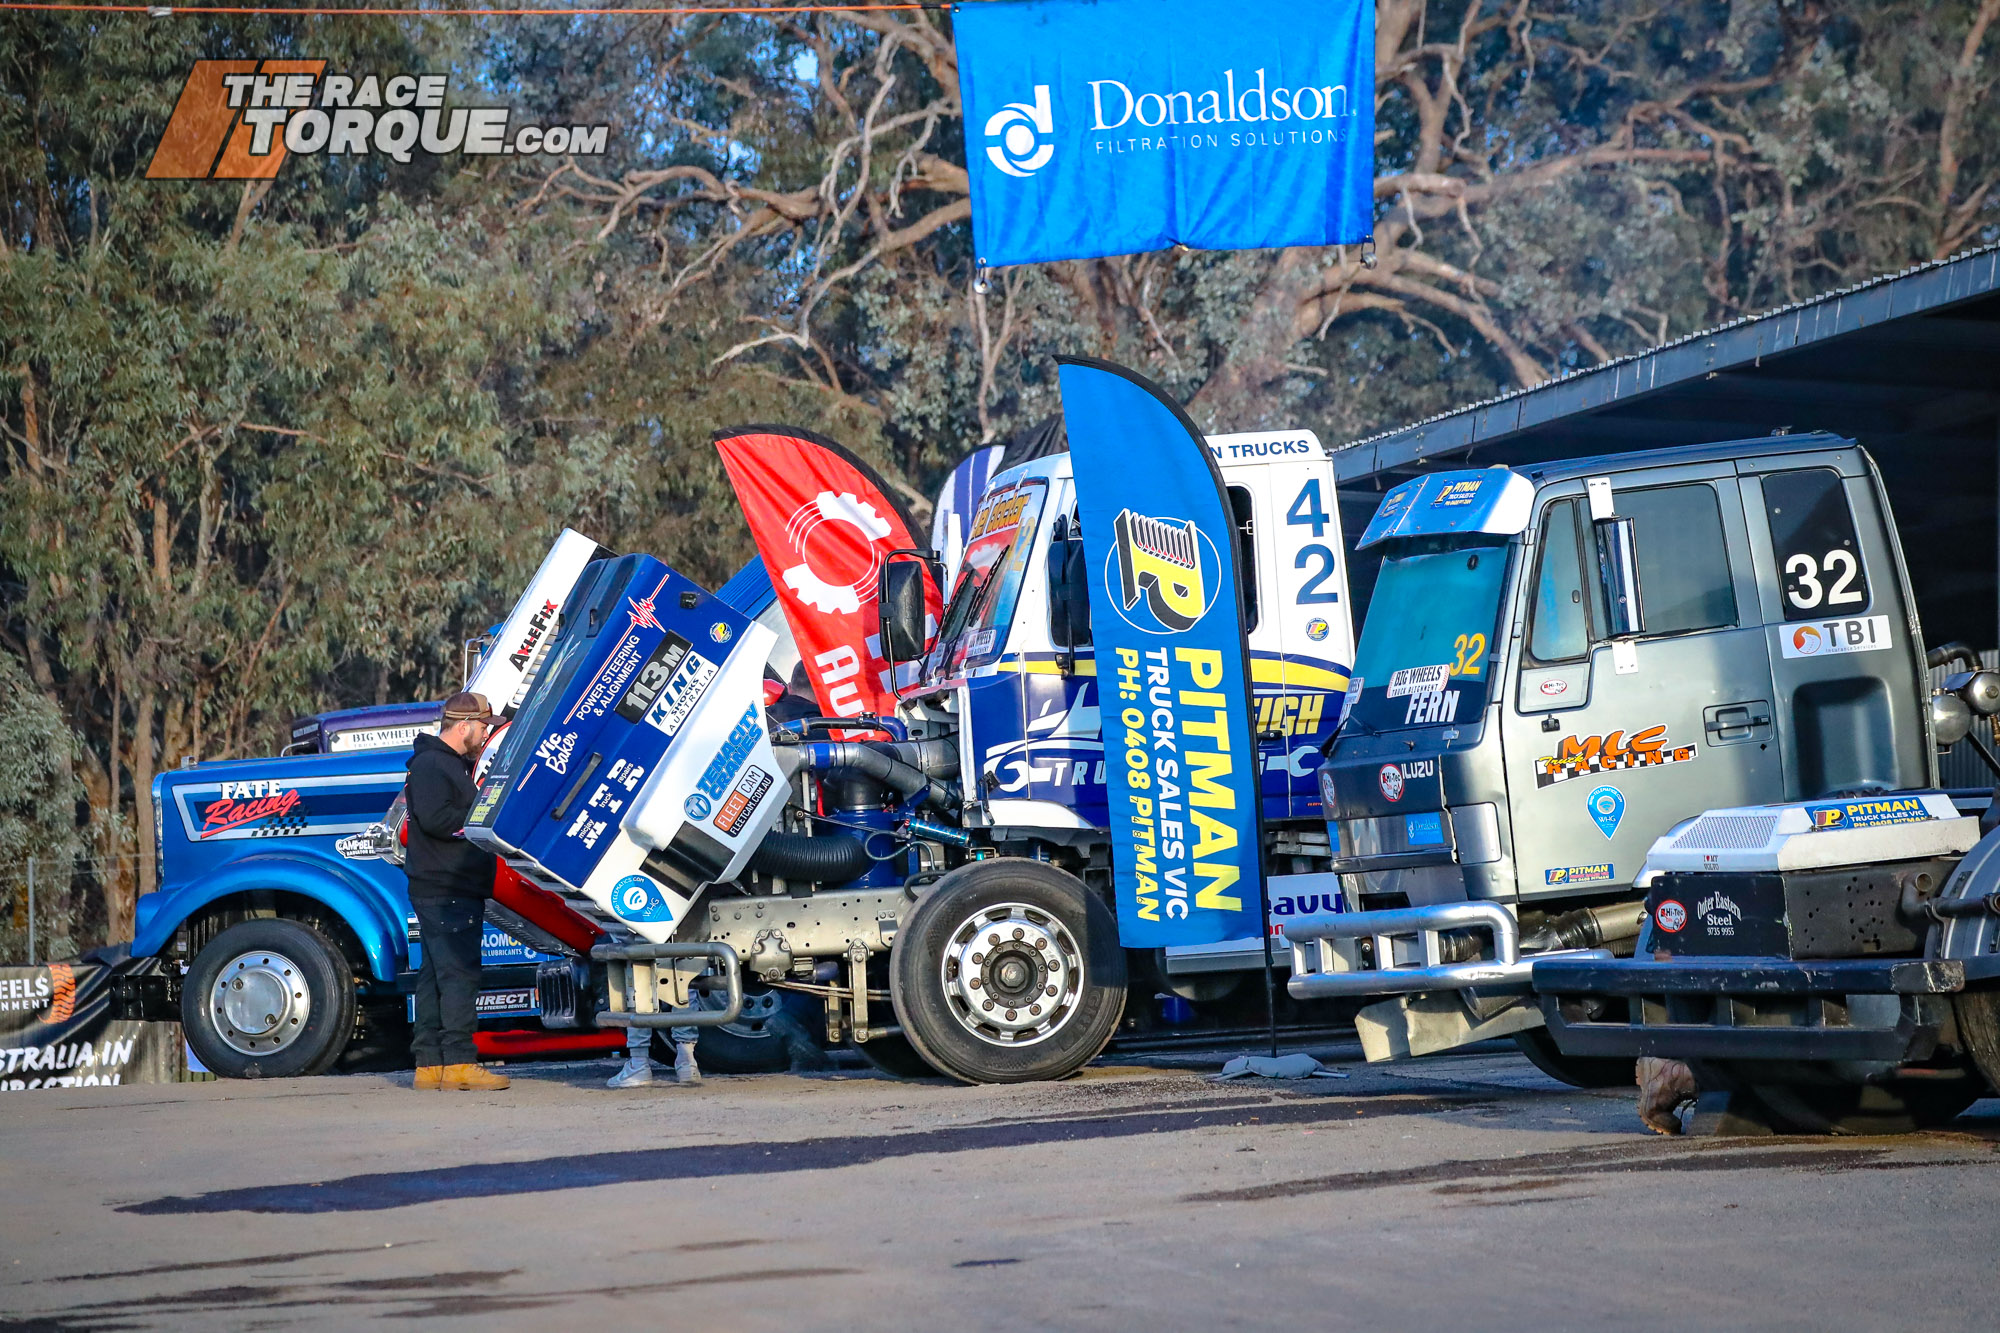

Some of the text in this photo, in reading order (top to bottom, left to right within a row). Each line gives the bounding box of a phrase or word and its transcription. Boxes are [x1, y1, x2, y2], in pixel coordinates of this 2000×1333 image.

[1087, 68, 1350, 130] Donaldson
[1096, 129, 1348, 154] FILTRATION SOLUTIONS
[1229, 440, 1310, 458] TRUCKS
[1452, 481, 1483, 493] PITMAN
[1786, 549, 1862, 609] 32
[1823, 619, 1876, 647] TBI
[1450, 633, 1485, 676] 32
[576, 635, 640, 720] POWER STEERING
[593, 650, 642, 717] & ALIGNMENT
[1394, 666, 1442, 686] BIG WHEELS
[651, 655, 700, 725] KING
[669, 669, 714, 731] AUSTRALIA
[671, 678, 699, 715] SHOCKS
[1392, 683, 1438, 696] TRUCK ALIGNMENT
[1405, 690, 1460, 724] FERN
[353, 733, 373, 742] BIG
[535, 733, 562, 758] Vic
[696, 703, 758, 794] TENACITY
[545, 732, 578, 774] Baker
[709, 724, 763, 801] CRANES
[1538, 753, 1585, 767] Truck
[1547, 749, 1690, 774] RACING
[221, 780, 282, 800] FATE
[599, 793, 613, 808] truck
[617, 763, 633, 783] repairs
[1115, 647, 1160, 922] PH: 0408 PITMAN
[1145, 647, 1189, 920] TRUCK SALES VIC
[1175, 647, 1242, 911] PITMAN
[203, 789, 301, 830] Racing
[718, 771, 761, 827] FLEET CAM
[730, 777, 771, 835] FLEETCAM.COM.AU
[1846, 800, 1919, 816] PITMAN
[1850, 814, 1880, 822] TRUCK
[1881, 812, 1908, 820] SALES
[1569, 865, 1608, 875] PITMAN
[643, 898, 660, 917] WHG
[1268, 894, 1344, 916] avy
[1666, 907, 1683, 917] Hi-Tec
[1697, 891, 1741, 921] Outer Eastern
[1707, 914, 1733, 926] Steel
[1707, 927, 1735, 936] 9735 9955
[488, 948, 522, 956] LUBRICANTS
[1, 999, 49, 1011] NMENT
[476, 994, 528, 1006] IRECT
[102, 1040, 133, 1066] IN
